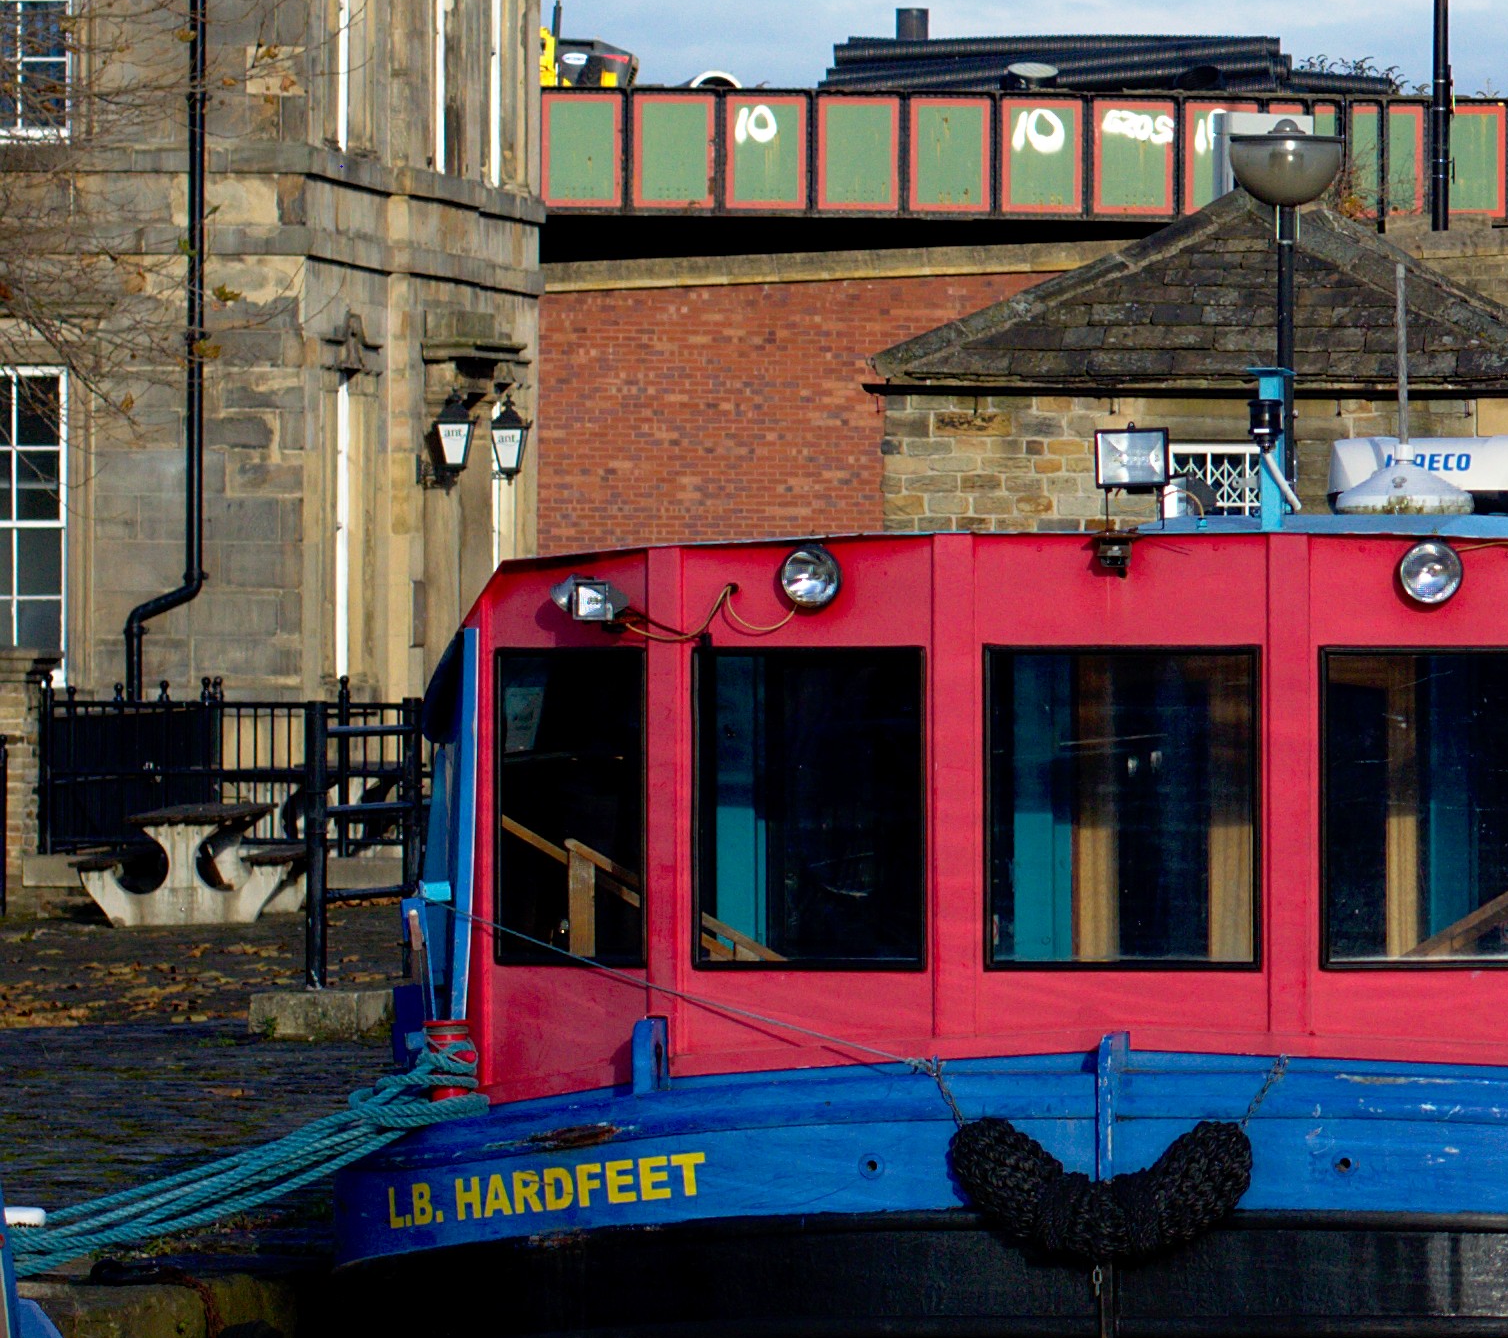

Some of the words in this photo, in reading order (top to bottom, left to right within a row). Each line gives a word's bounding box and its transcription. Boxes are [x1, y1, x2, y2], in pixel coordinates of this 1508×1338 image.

[735, 105, 777, 144] 10
[1012, 108, 1065, 153] 10
[388, 1181, 444, 1229] L.B.
[455, 1152, 706, 1221] HARDFEET
